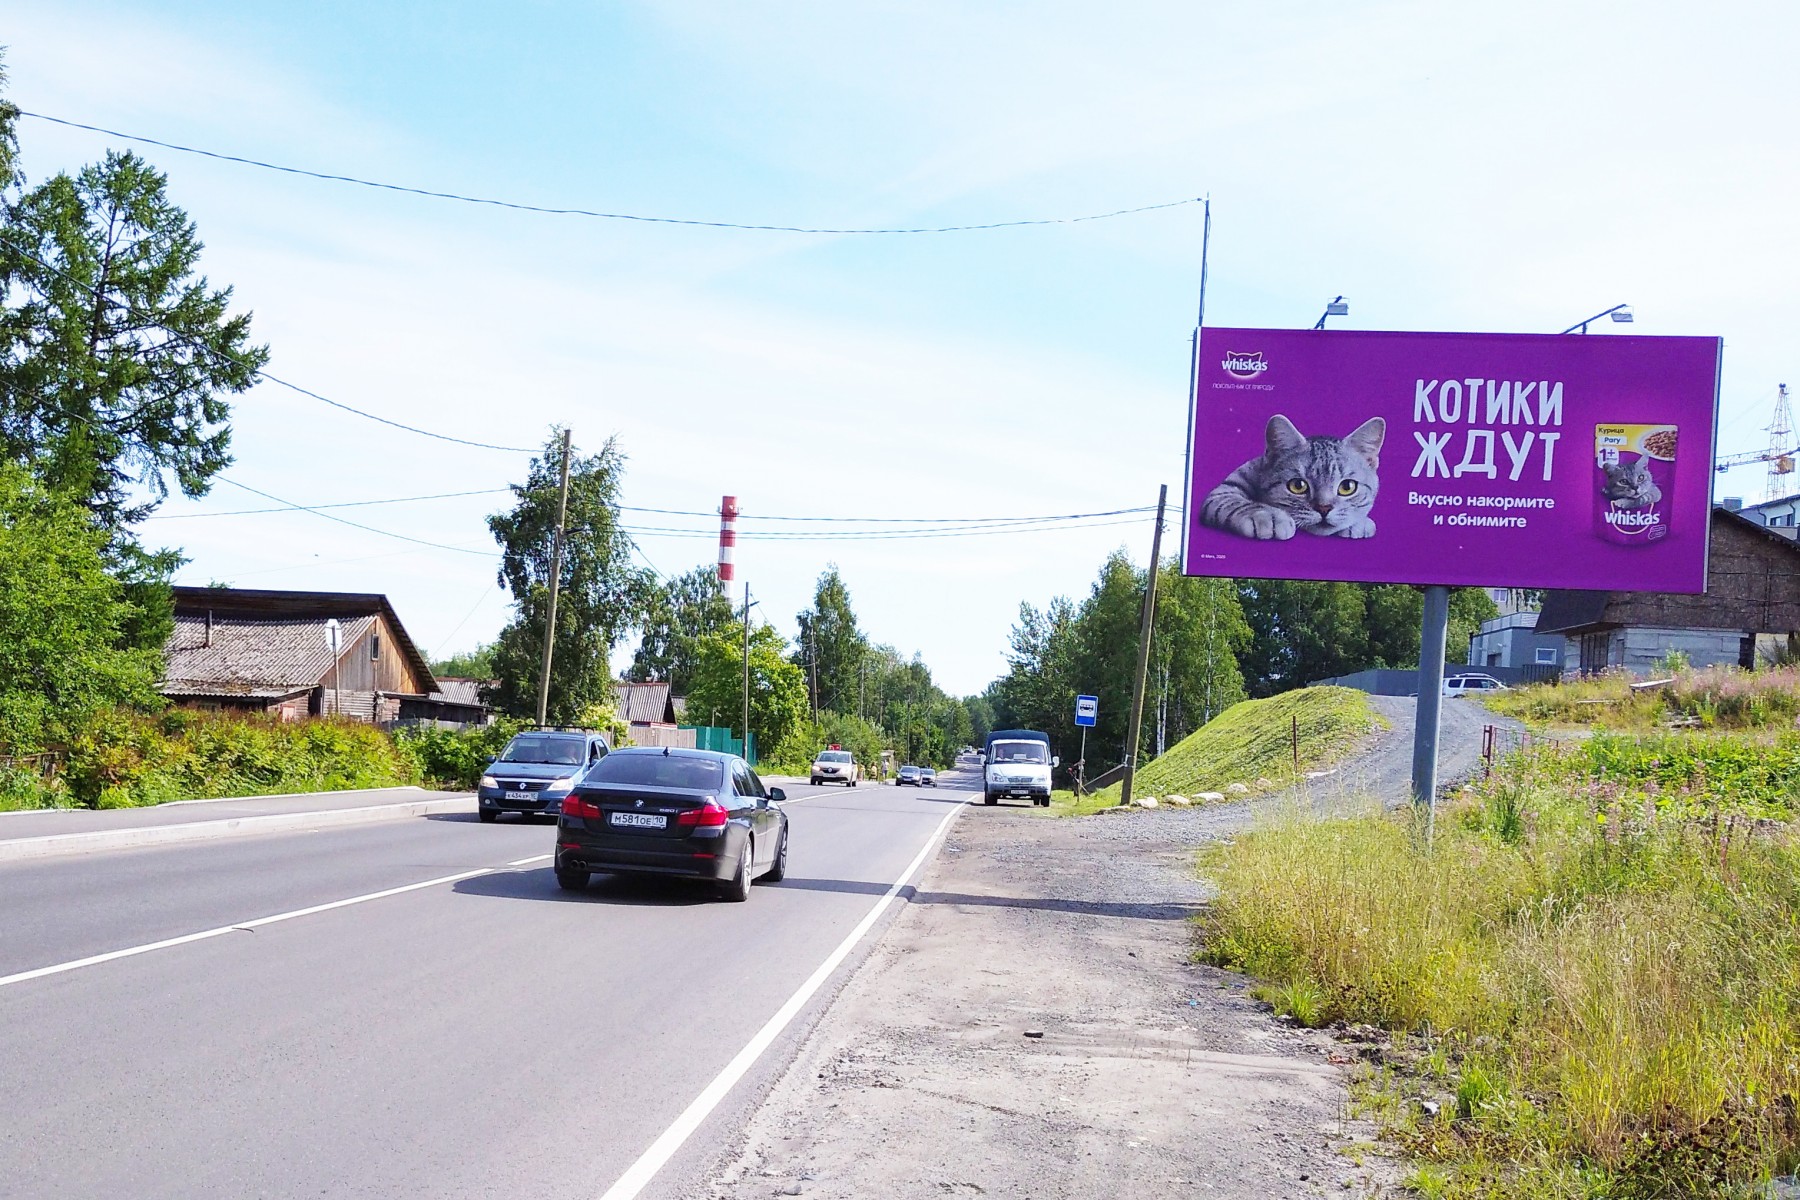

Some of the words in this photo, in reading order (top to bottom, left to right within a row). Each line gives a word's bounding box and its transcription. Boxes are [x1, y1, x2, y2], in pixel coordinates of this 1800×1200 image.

[1221, 358, 1268, 371] whiskas
[1413, 378, 1563, 425] КОТИКИ
[1598, 427, 1625, 435] Курица
[1411, 430, 1560, 481] ЖДУТ
[1599, 448, 1616, 462] 1+
[1408, 491, 1463, 508] Вкусно
[1467, 496, 1555, 511] накормите
[1433, 514, 1444, 525] и
[1447, 512, 1527, 528] обнимите
[1604, 510, 1661, 526] whiskas
[614, 814, 652, 826] М581ОЕ
[654, 816, 664, 824] 10
